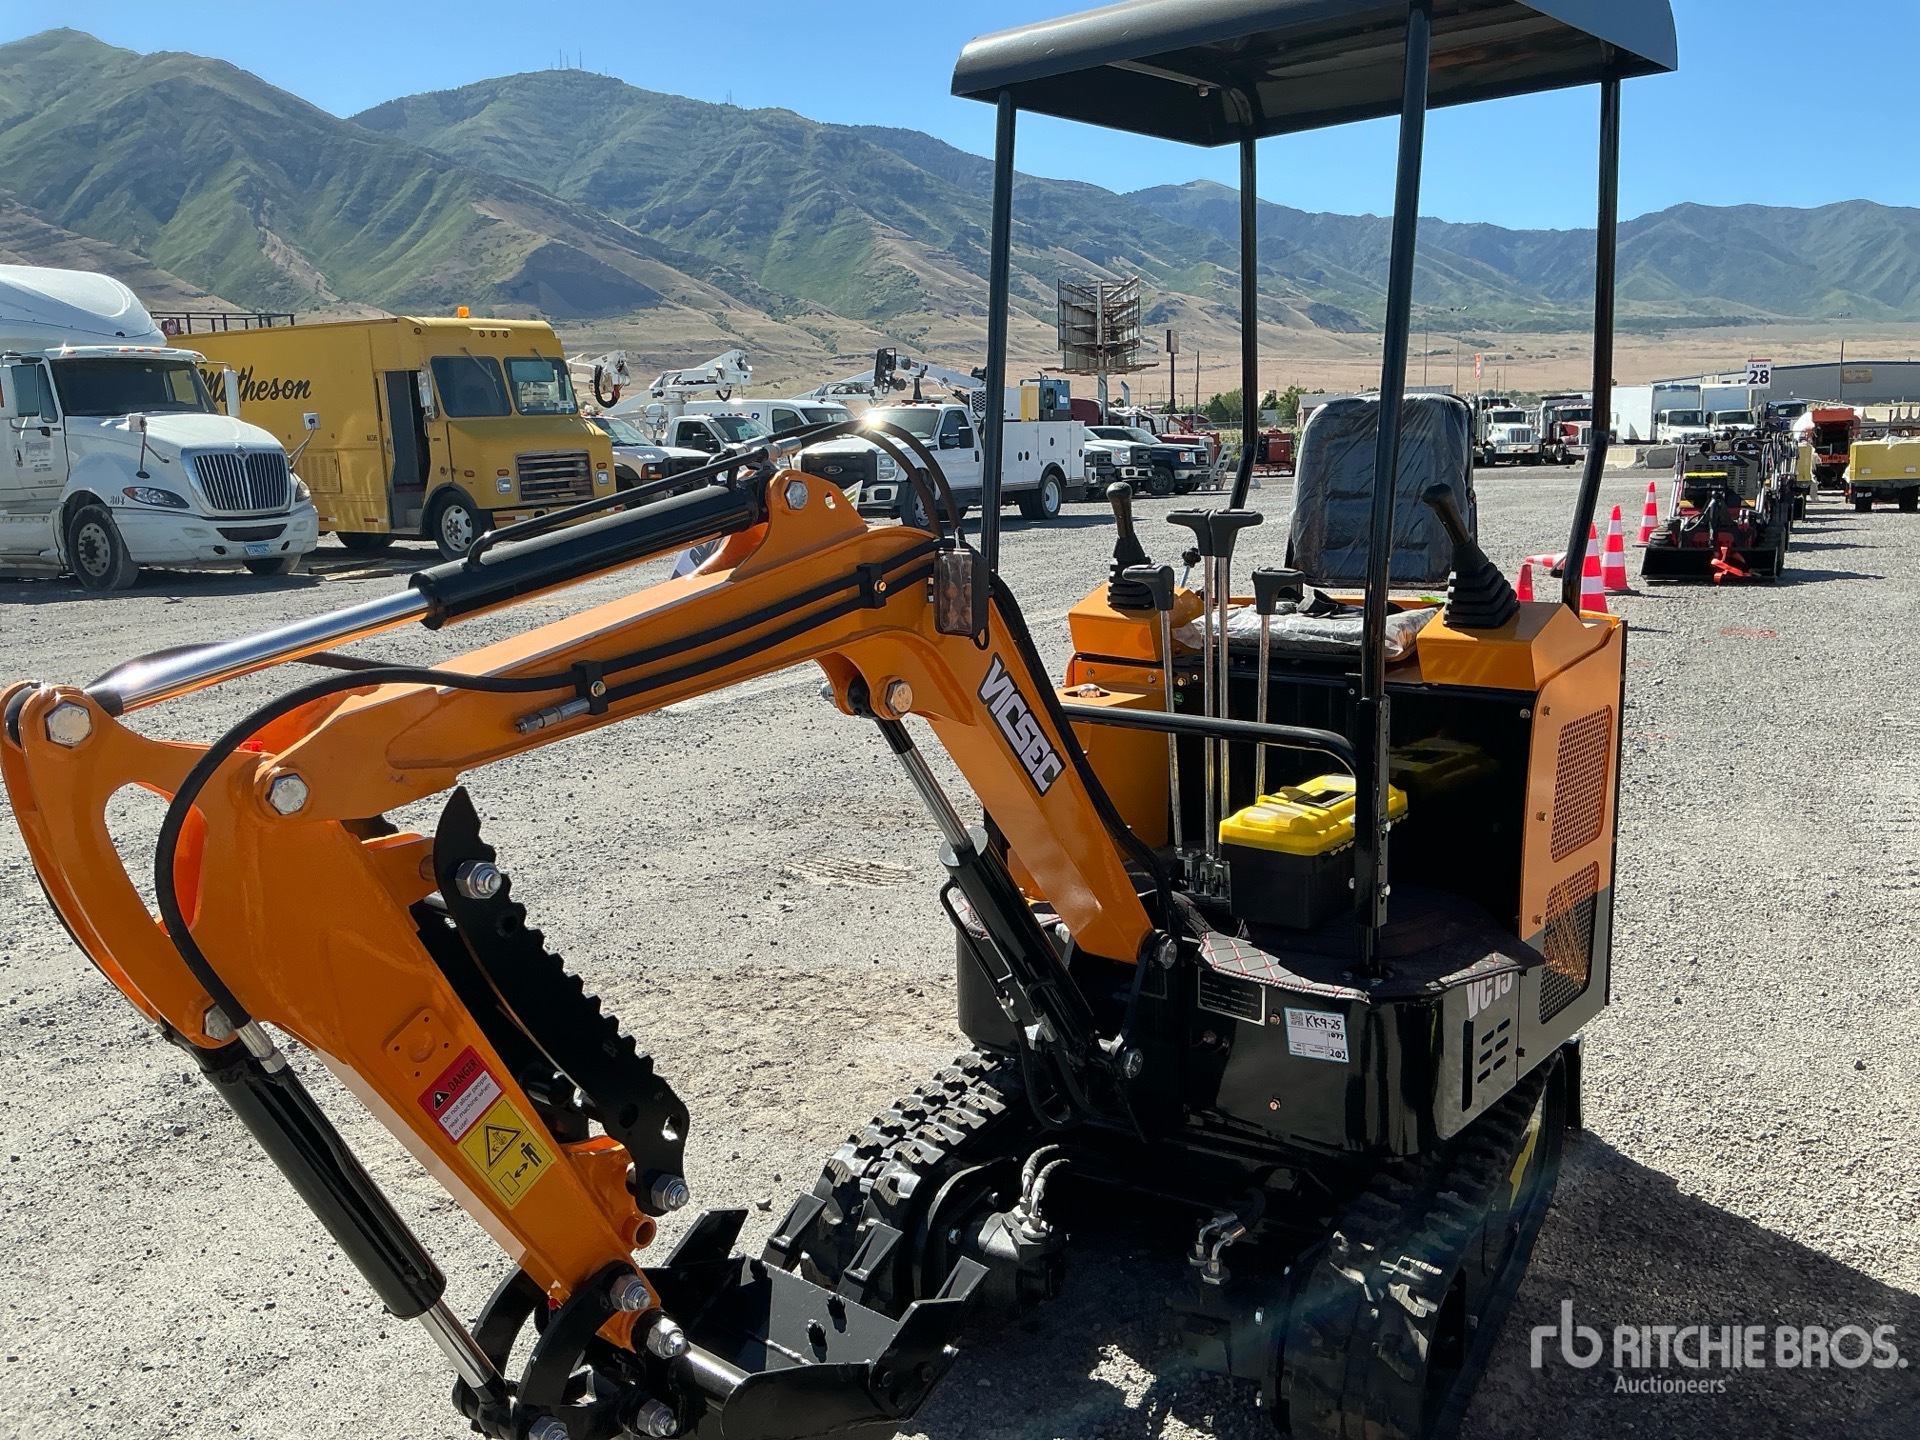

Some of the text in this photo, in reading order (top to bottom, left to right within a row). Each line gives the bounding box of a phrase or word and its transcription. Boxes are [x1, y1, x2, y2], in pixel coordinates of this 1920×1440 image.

[199, 365, 312, 402] Mtheson
[1748, 370, 1769, 384] 28
[977, 652, 1067, 797] VICSEC
[1305, 1014, 1341, 1030] KK9-25
[448, 1059, 478, 1091] DANGER
[442, 1073, 489, 1124] Do not allow people
[448, 1082, 492, 1130] near machine when
[453, 1128, 460, 1137] in
